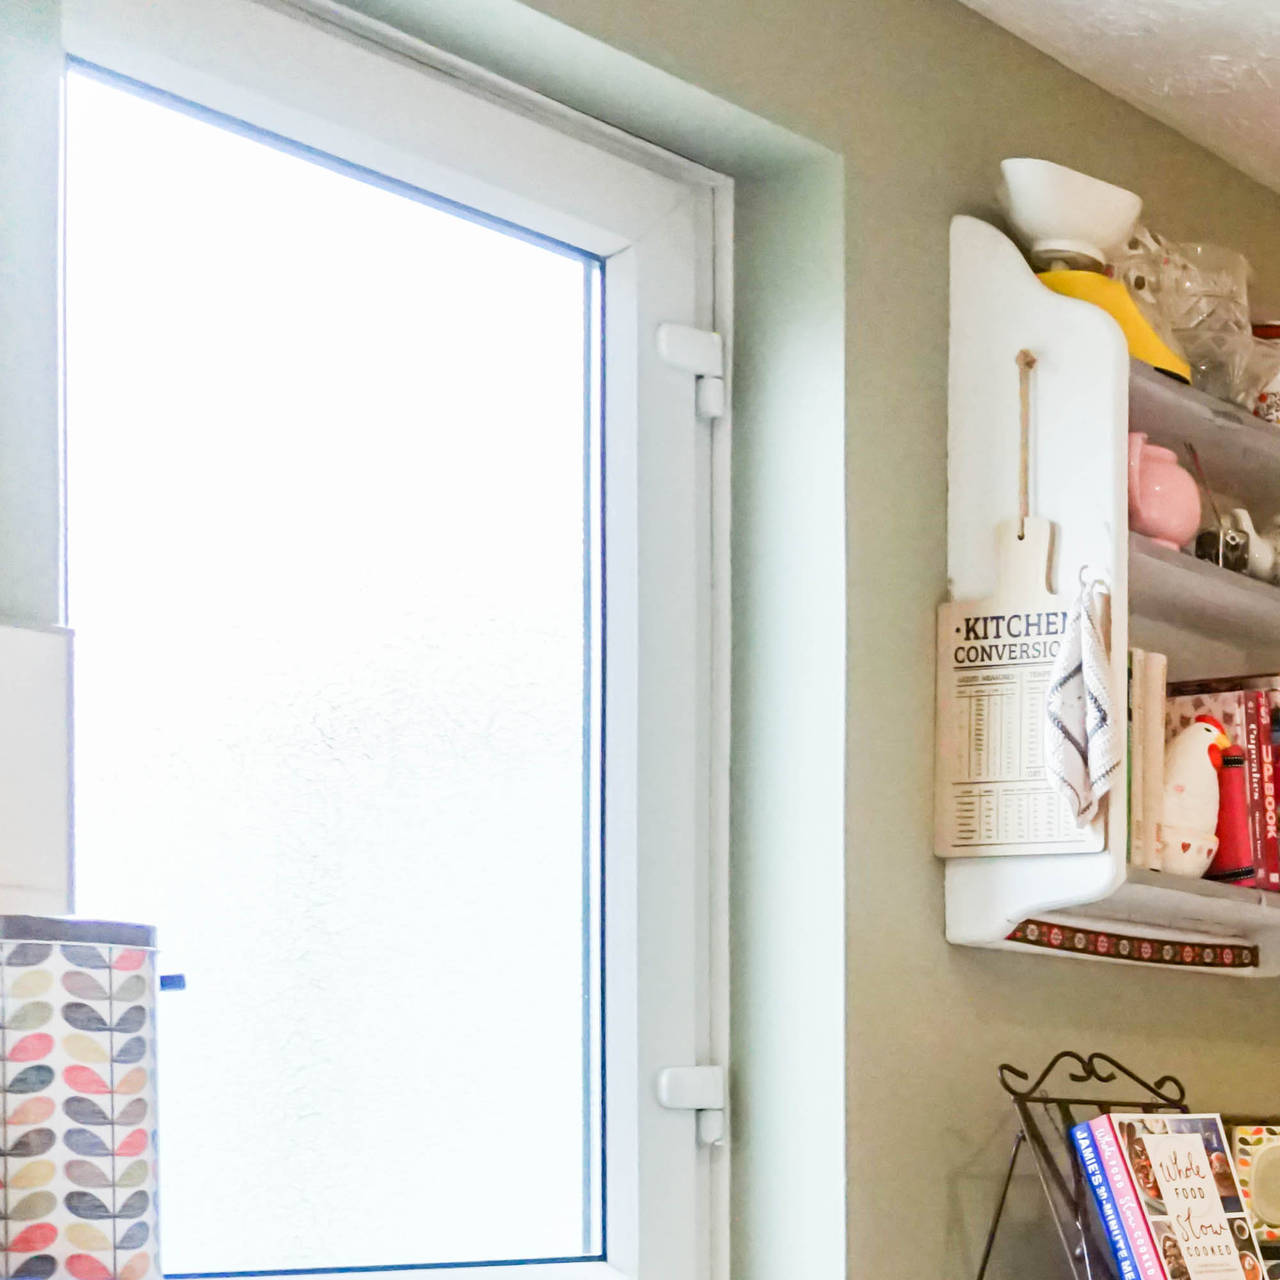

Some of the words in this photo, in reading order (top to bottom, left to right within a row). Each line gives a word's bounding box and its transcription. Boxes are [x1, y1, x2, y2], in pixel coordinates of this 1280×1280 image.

[954, 640, 1061, 664] CONVERSIO
[1160, 1151, 1206, 1182] Whole
[1075, 1130, 1103, 1186] JAMIE'S
[1095, 1186, 1129, 1259] 30-MINUTE
[1174, 1187, 1205, 1199] FOOD
[1109, 1160, 1124, 1188] FOOD
[1134, 1231, 1155, 1276] COOKED
[1176, 1207, 1228, 1242] Slow
[1186, 1244, 1232, 1257] COOKED
